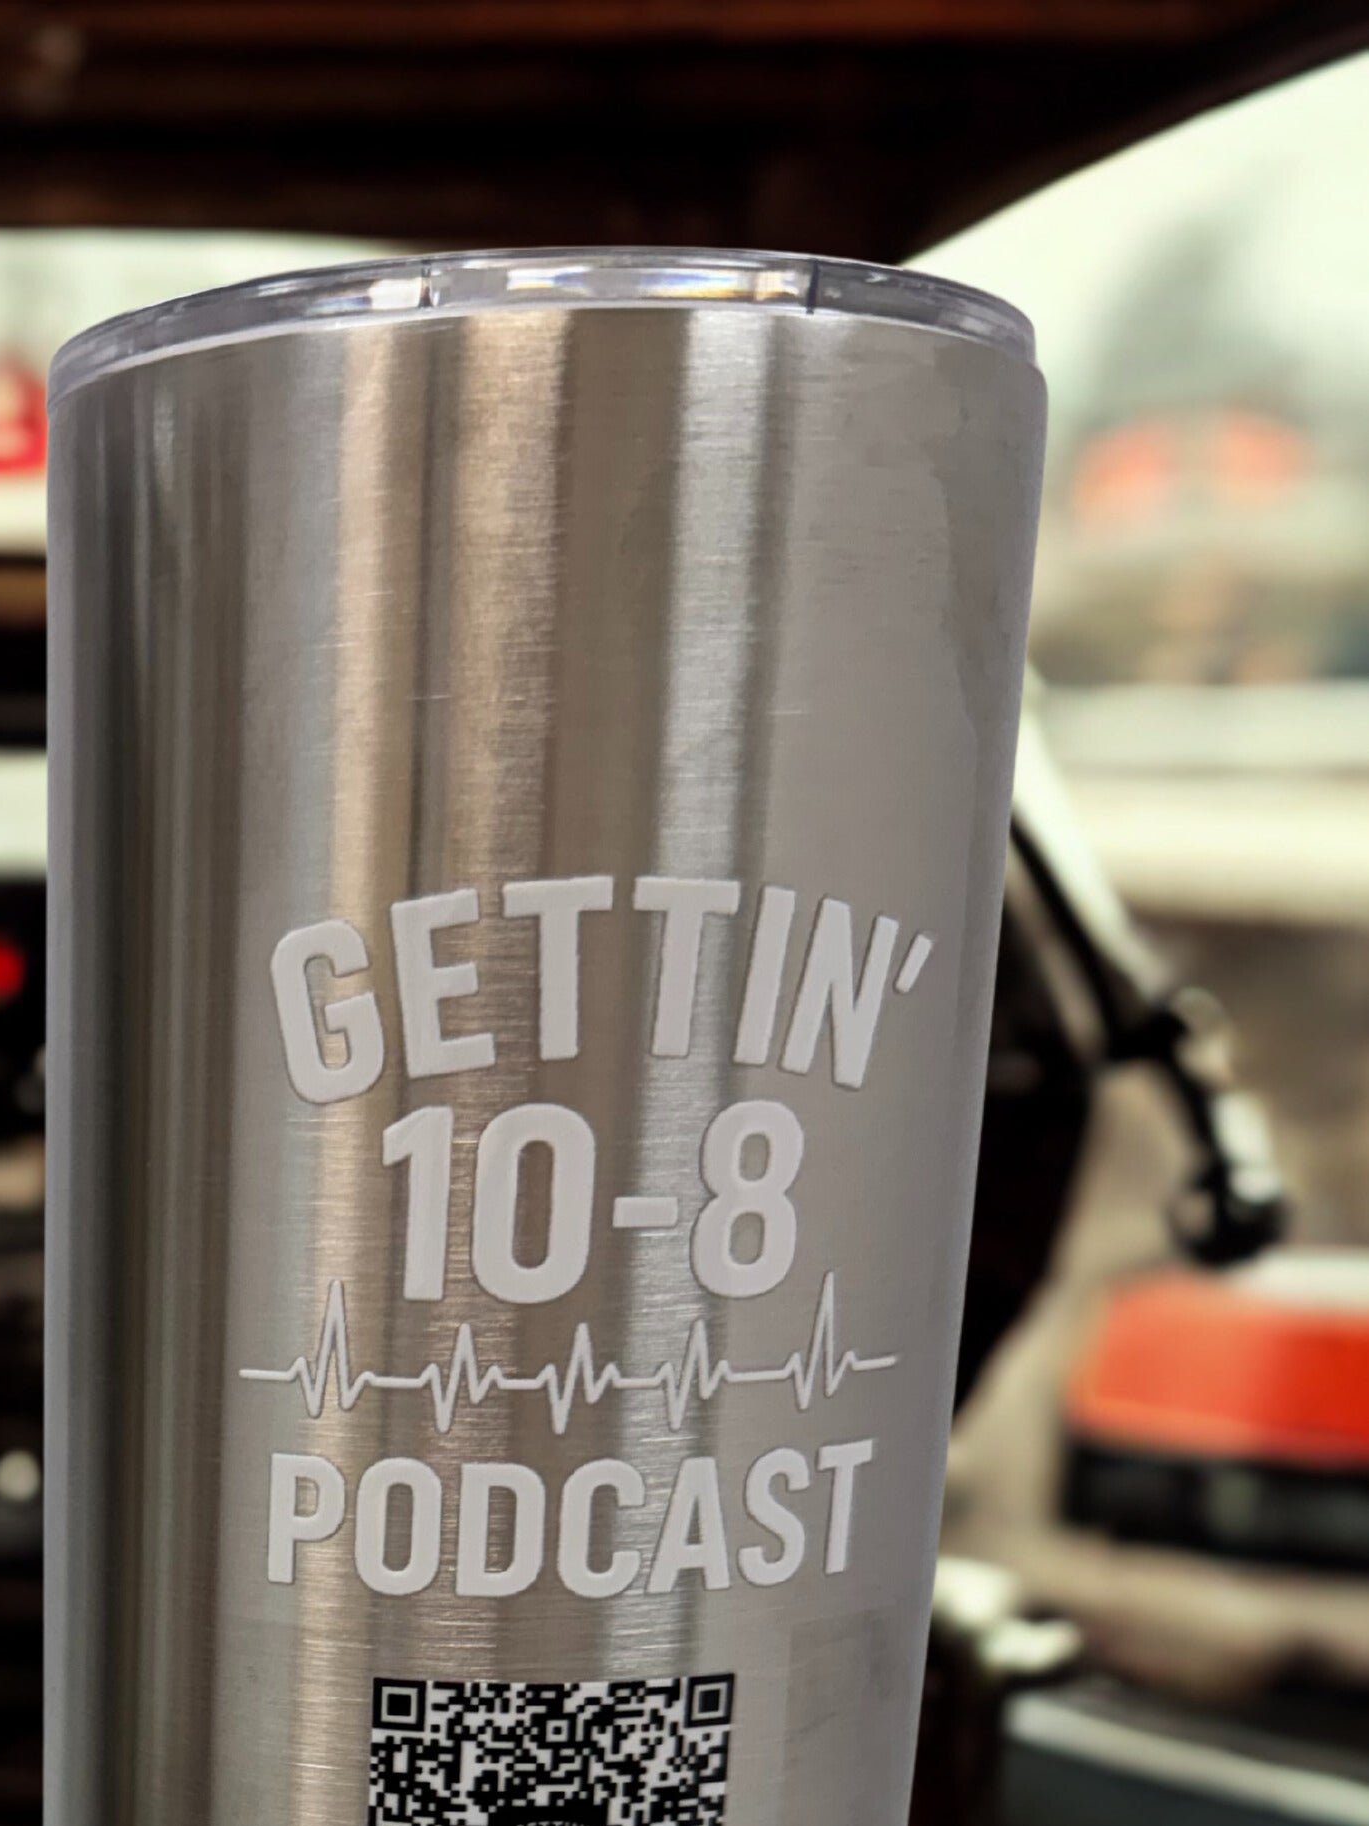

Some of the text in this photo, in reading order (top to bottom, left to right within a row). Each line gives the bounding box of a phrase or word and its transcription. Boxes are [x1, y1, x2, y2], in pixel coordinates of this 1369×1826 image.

[271, 875, 932, 1104] GETTIN'
[382, 1100, 804, 1305] 10-8
[267, 1439, 874, 1599] PODCAST
